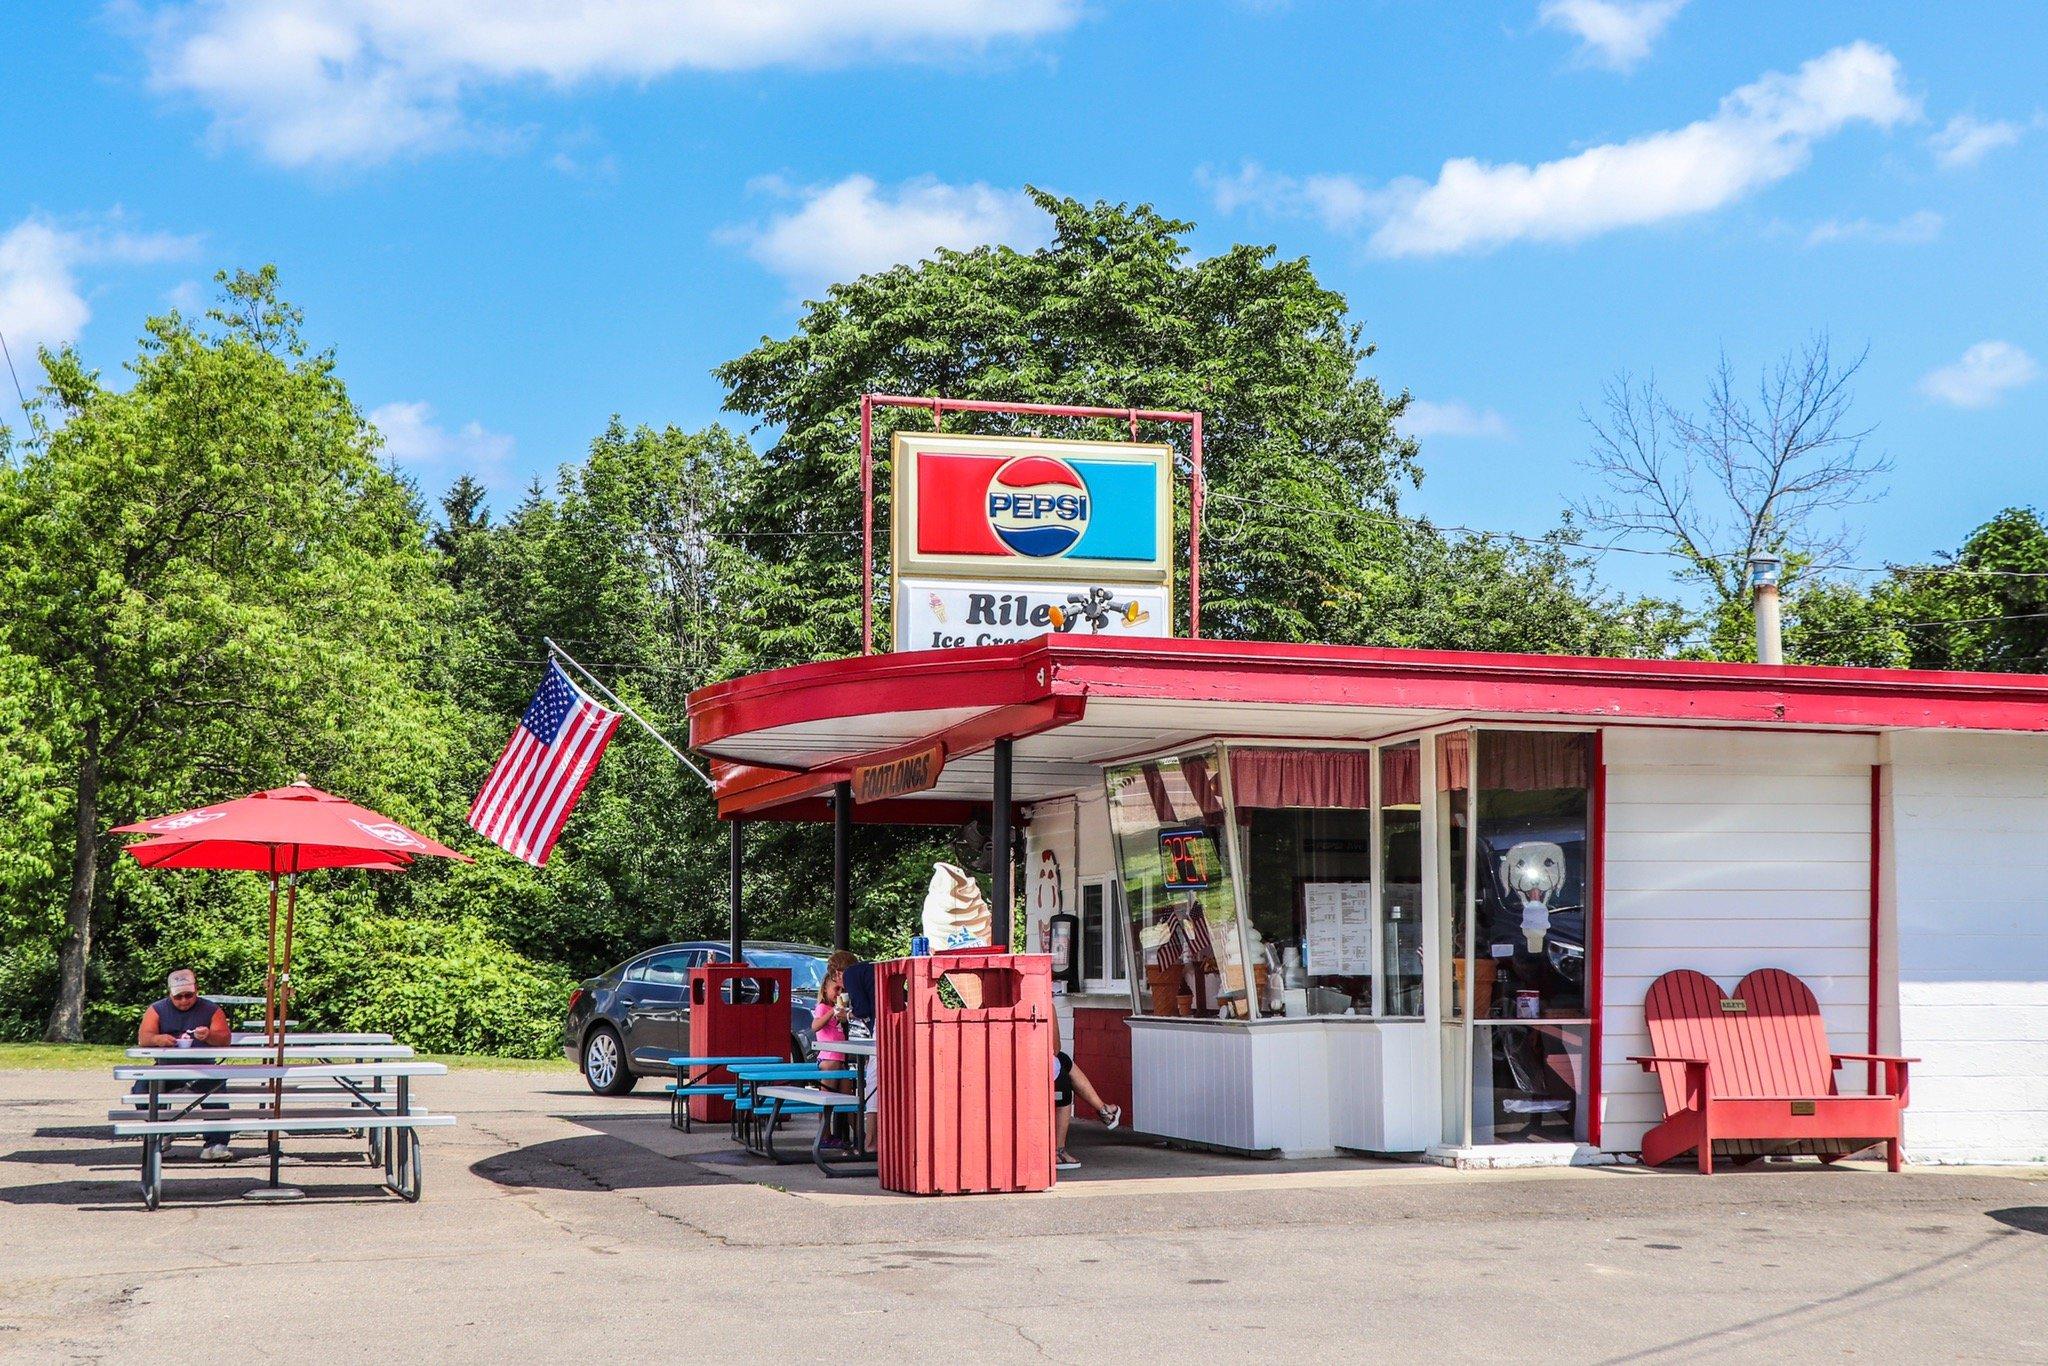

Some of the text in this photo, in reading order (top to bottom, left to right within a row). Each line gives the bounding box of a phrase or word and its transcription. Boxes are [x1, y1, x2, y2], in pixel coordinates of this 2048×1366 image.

[990, 492, 1086, 520] PEPSI
[966, 592, 1109, 632] Rile
[932, 631, 965, 648] Ice
[863, 754, 930, 798] FOOTLONGS
[1163, 836, 1207, 882] OPEN
